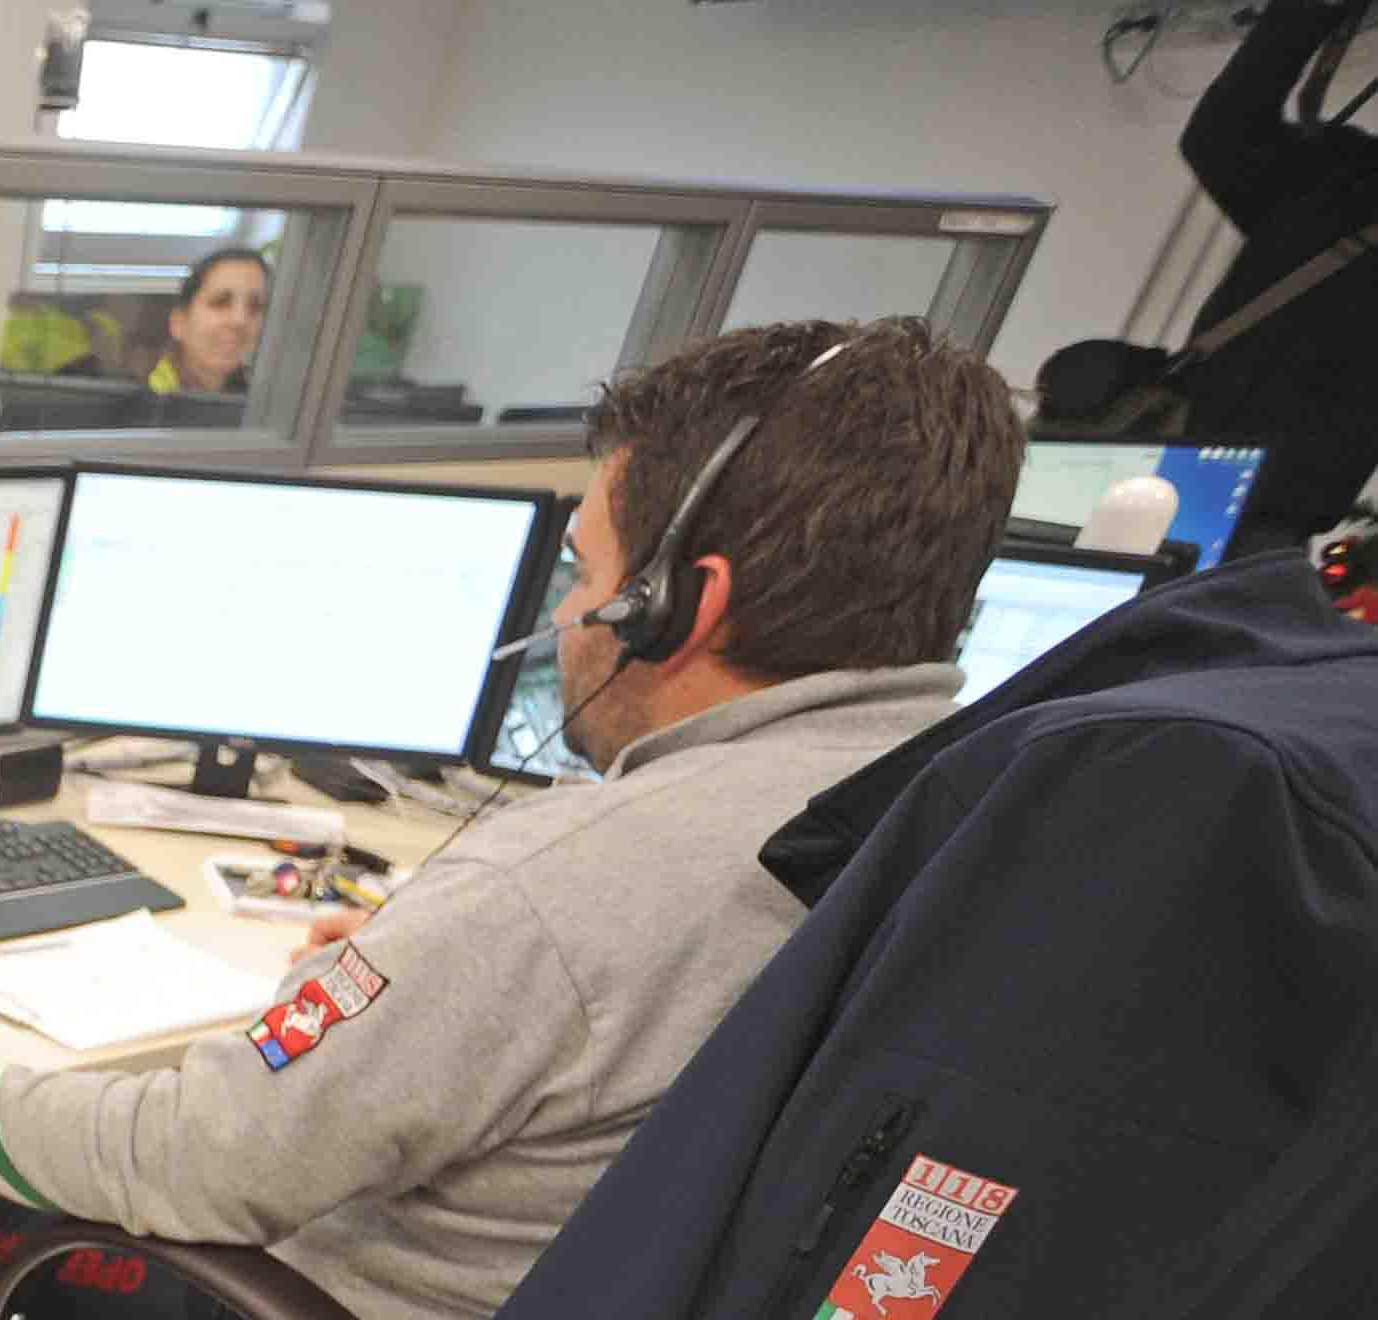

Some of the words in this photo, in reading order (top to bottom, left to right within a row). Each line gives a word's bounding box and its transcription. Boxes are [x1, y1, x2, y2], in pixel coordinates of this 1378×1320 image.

[914, 1163, 1007, 1211] 118
[893, 1205, 975, 1250] TOSCANA
[900, 1189, 989, 1234] REGIONE
